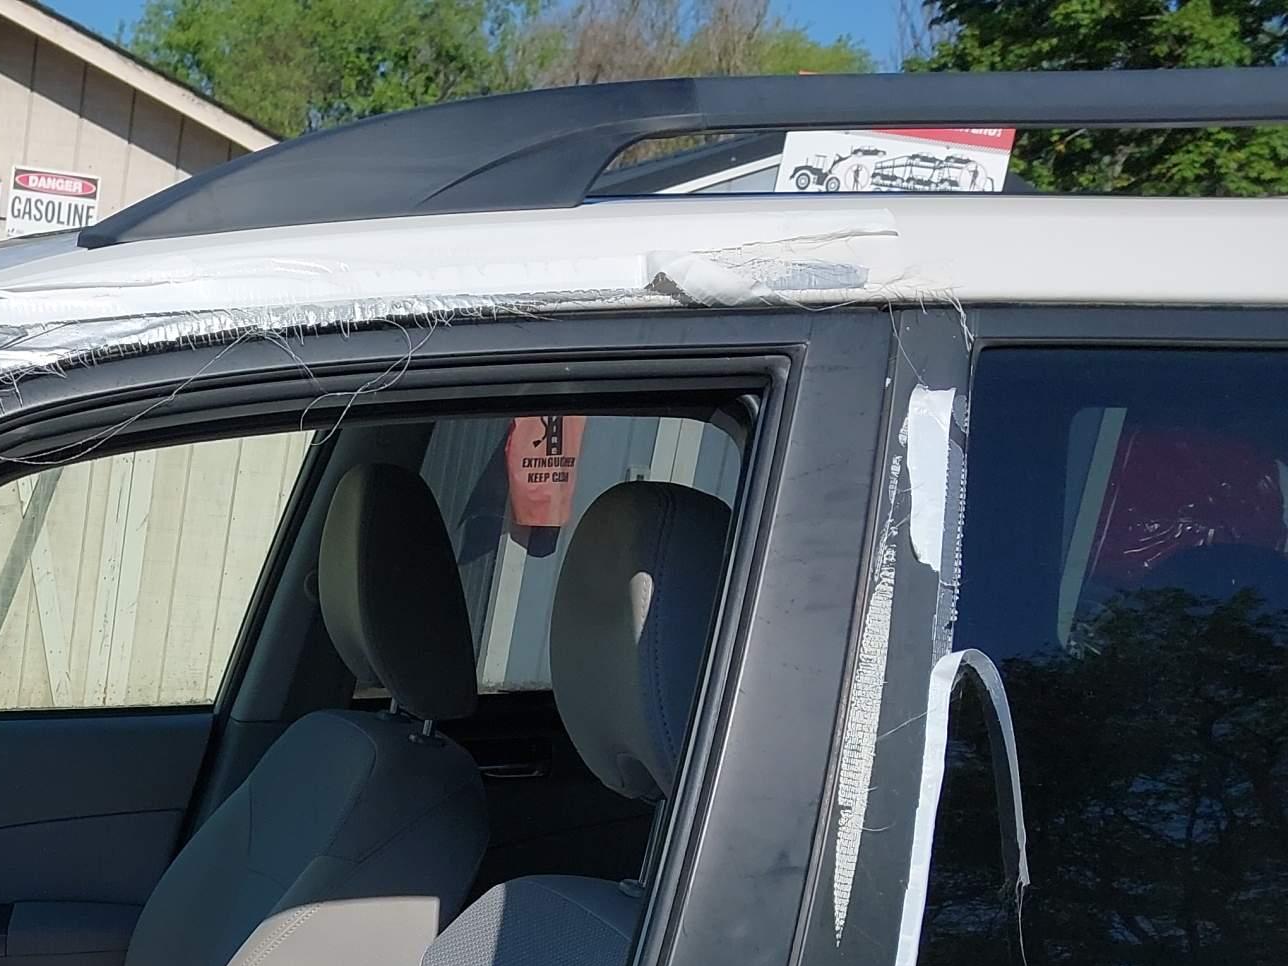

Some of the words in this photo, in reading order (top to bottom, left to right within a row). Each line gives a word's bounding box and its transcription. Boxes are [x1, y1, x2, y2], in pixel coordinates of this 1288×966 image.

[27, 175, 83, 193] DANGER
[11, 195, 96, 227] GASOLINE
[527, 472, 550, 483] KEEP
